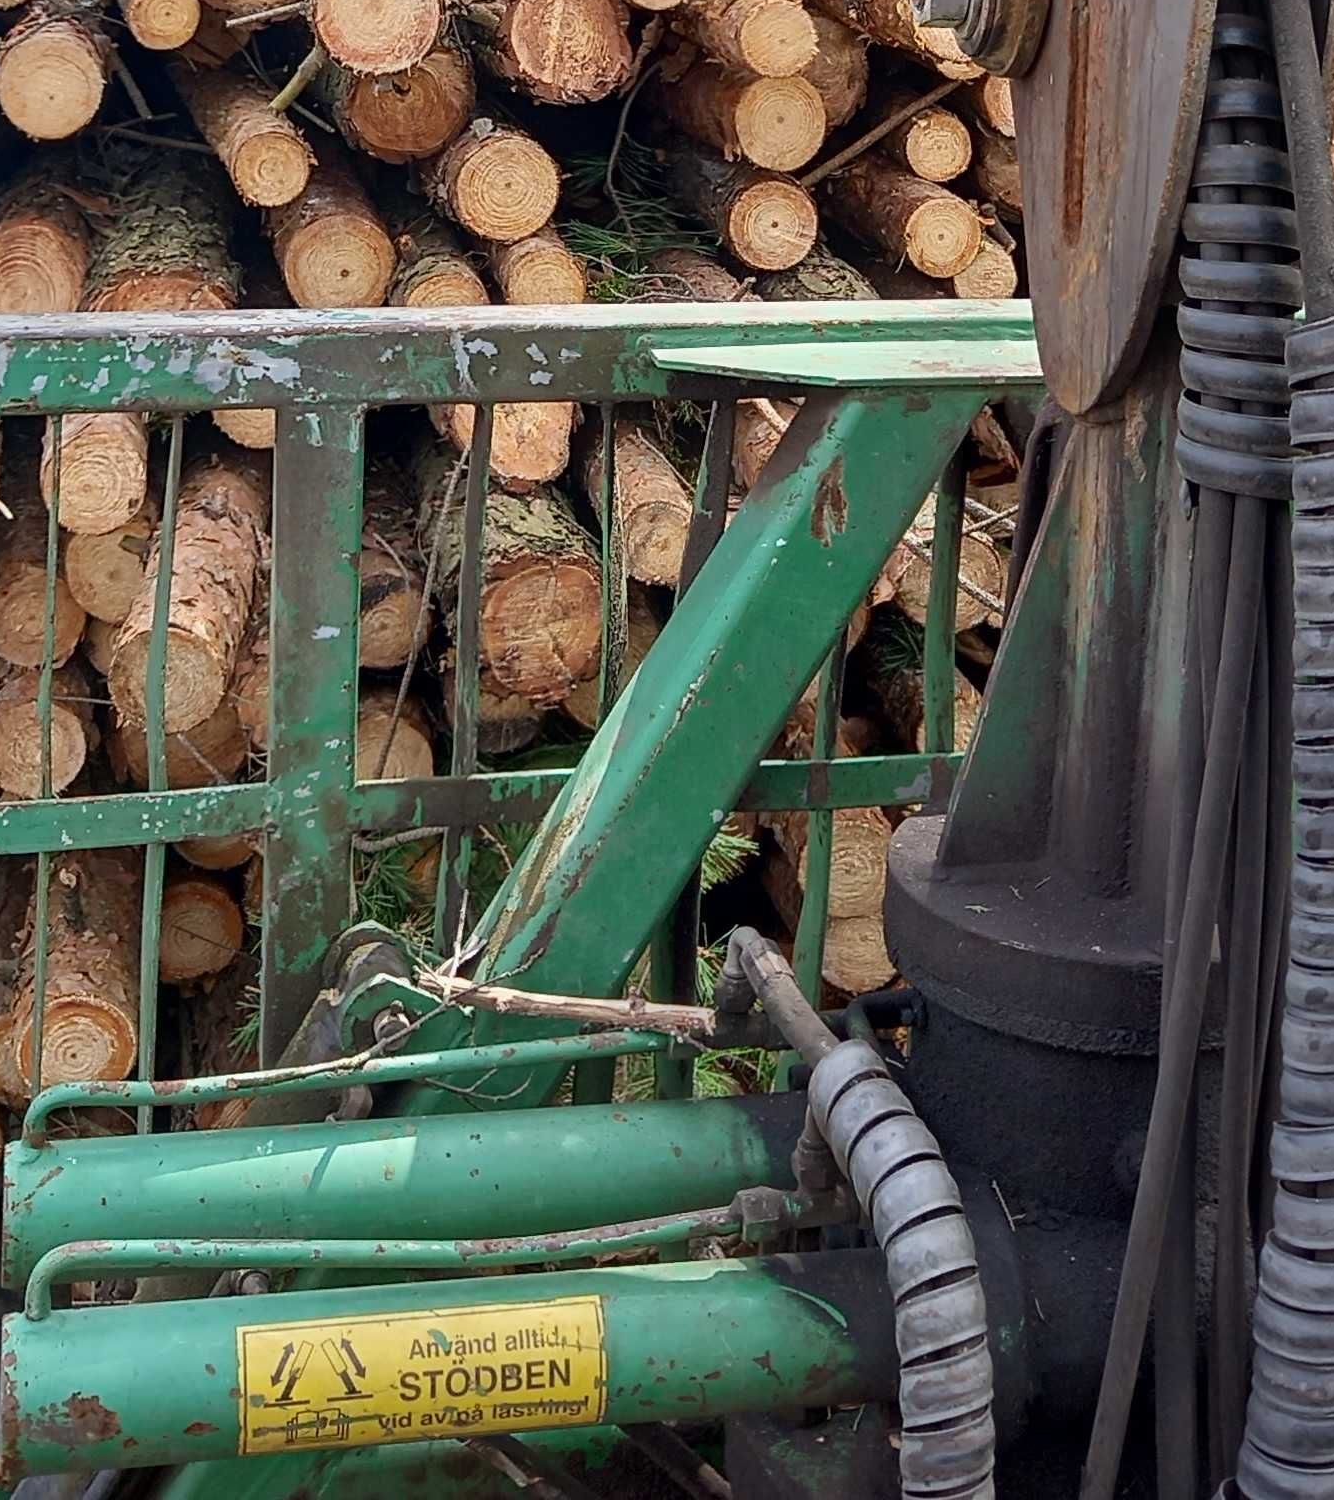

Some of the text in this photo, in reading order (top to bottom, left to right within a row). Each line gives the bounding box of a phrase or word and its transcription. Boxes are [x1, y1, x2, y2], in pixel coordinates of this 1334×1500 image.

[409, 1325, 560, 1360] Använd alltid
[399, 1359, 571, 1401] STÖDBEN
[378, 1411, 412, 1429] vid
